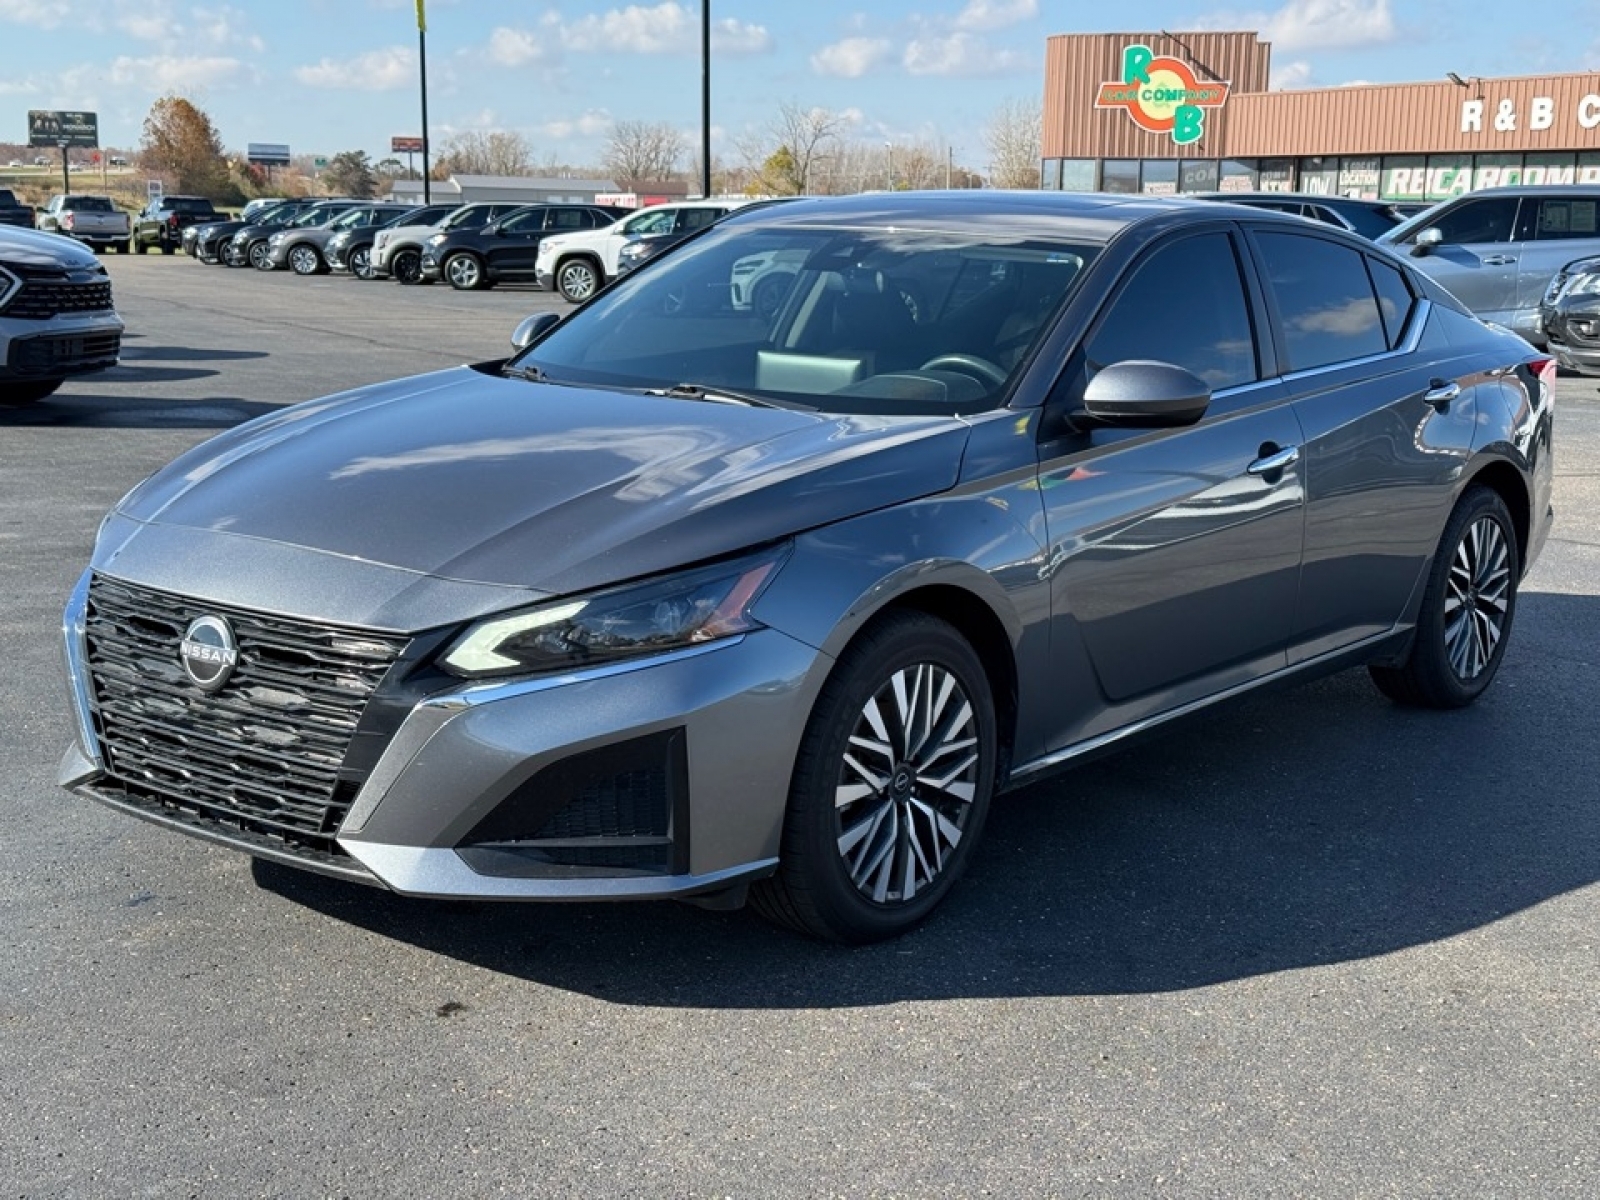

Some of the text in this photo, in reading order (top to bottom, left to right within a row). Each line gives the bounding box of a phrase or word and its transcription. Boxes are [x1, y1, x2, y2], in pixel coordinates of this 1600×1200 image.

[1124, 45, 1153, 85] R
[1142, 88, 1220, 102] COMPANY
[1173, 105, 1204, 144] B
[1461, 100, 1483, 133] R
[1495, 98, 1516, 131] &
[1530, 97, 1554, 130] B
[180, 641, 236, 665] NISSAN
